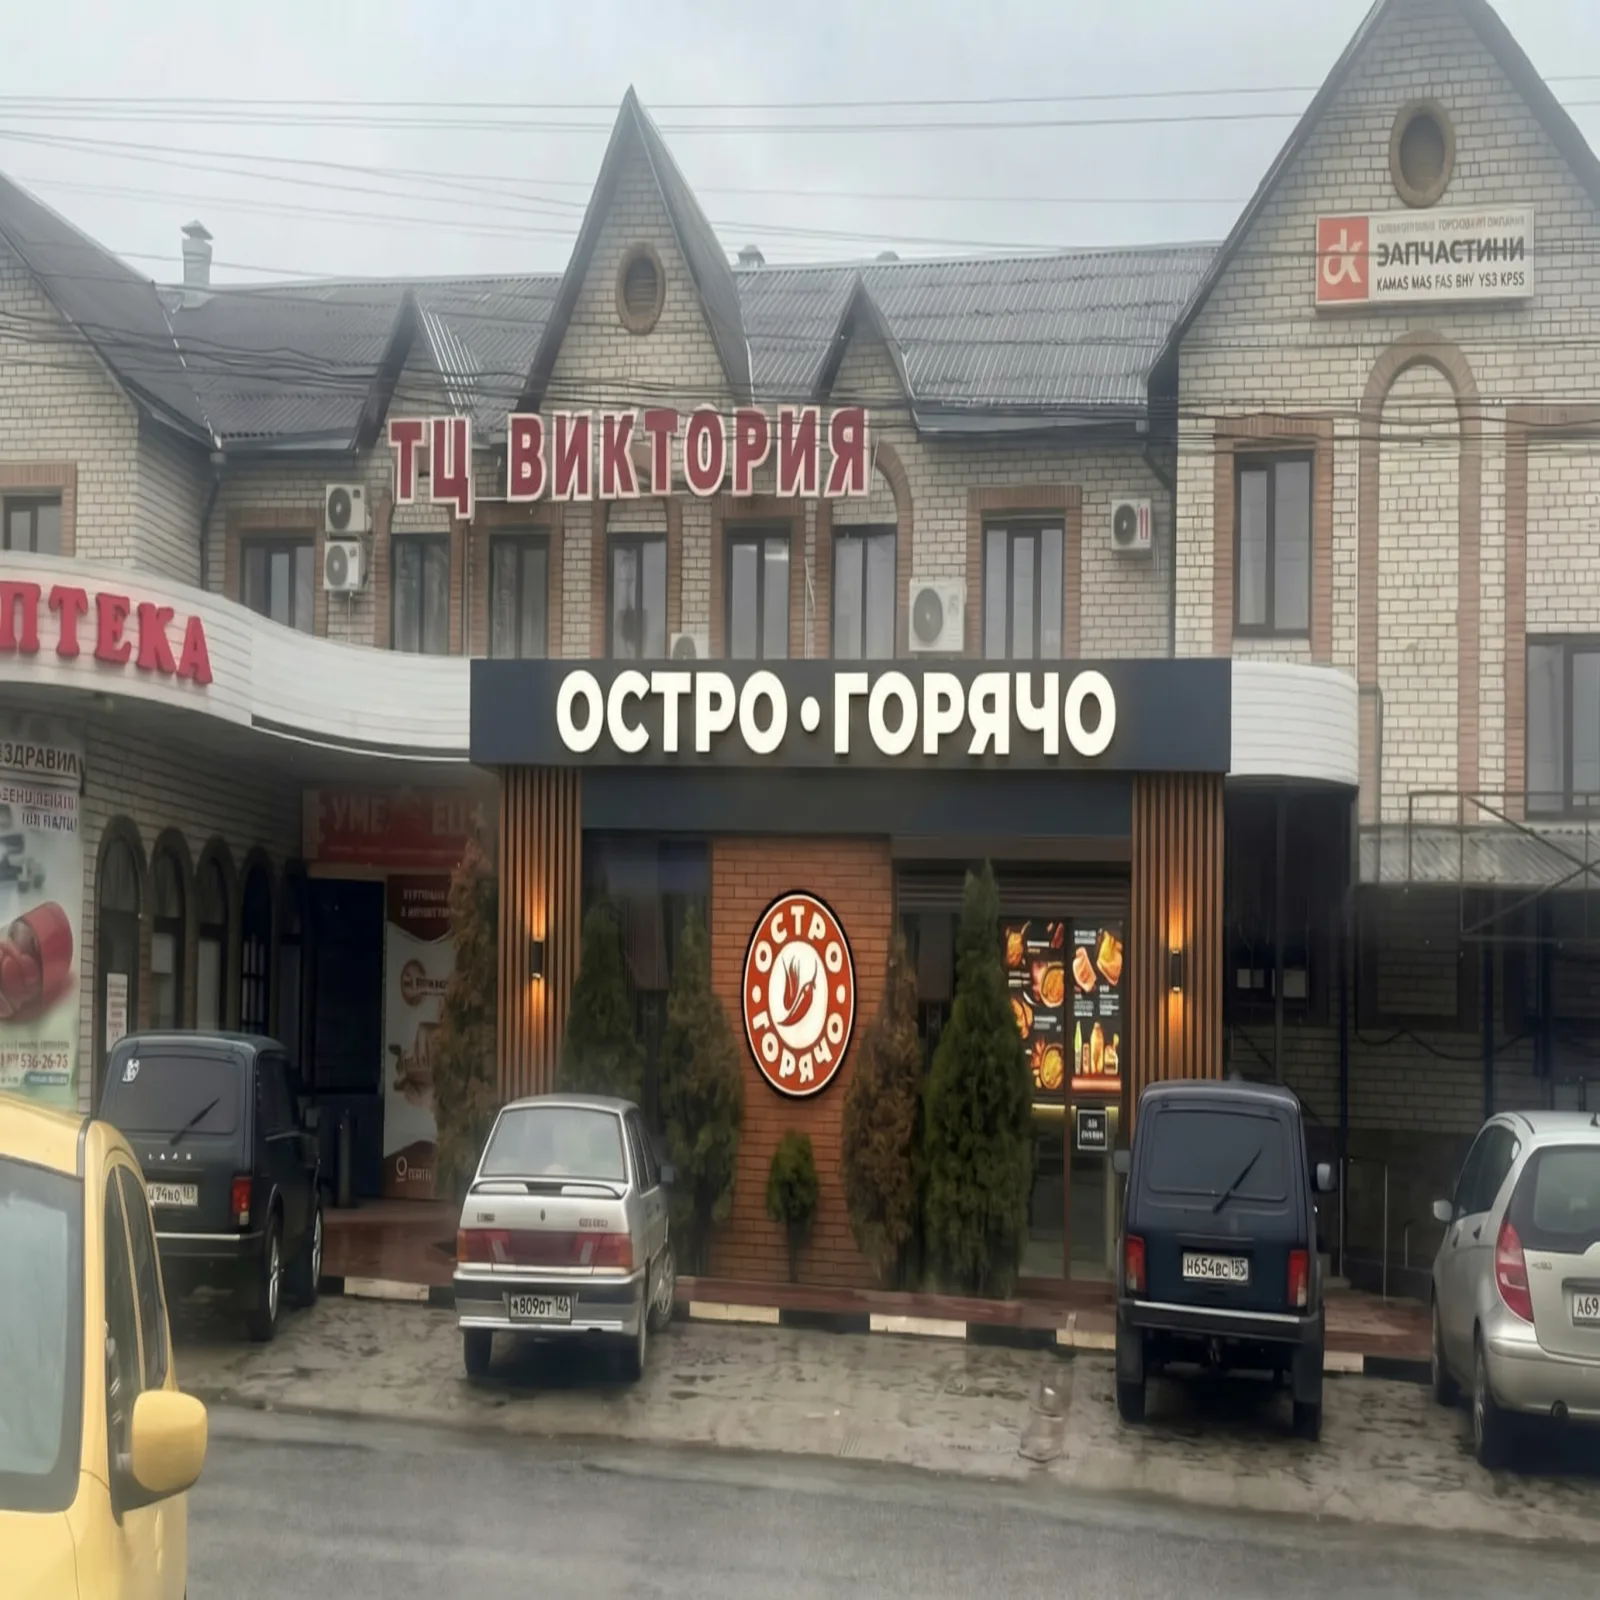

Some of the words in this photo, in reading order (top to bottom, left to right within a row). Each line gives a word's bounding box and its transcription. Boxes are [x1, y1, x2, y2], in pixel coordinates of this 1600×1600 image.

[388, 416, 474, 520] ТЦ
[507, 404, 869, 501] ВИКТОРИЯ
[0, 580, 213, 684] ПТЕКА
[556, 669, 788, 754] ОСТРО
[834, 670, 1117, 756] ГОРЯЧО
[755, 905, 843, 973] ОСТРО
[752, 1011, 844, 1083] ГОРЯЧО
